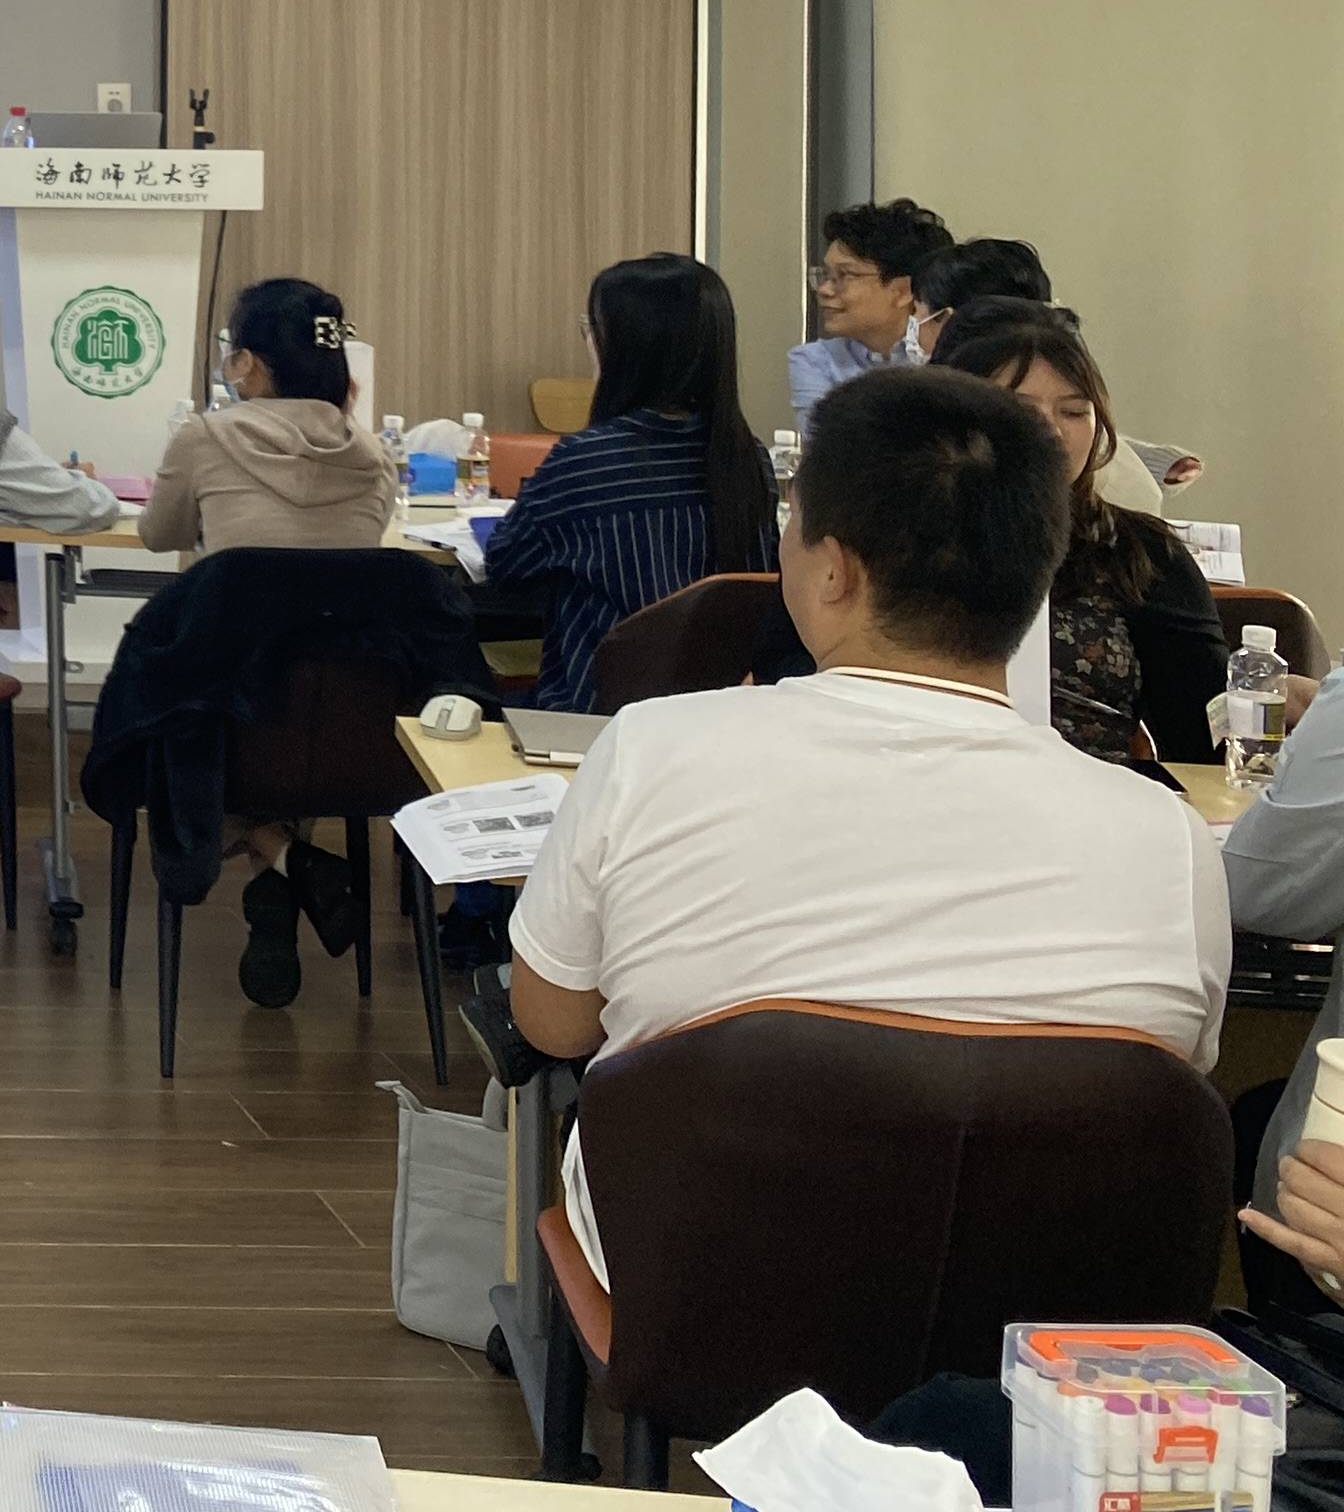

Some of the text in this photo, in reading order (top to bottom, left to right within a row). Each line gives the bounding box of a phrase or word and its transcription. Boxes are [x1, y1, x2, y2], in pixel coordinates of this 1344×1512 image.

[36, 157, 211, 189] 海南师范大学
[35, 191, 209, 203] HAINAN NORMAL UNIVERSITY
